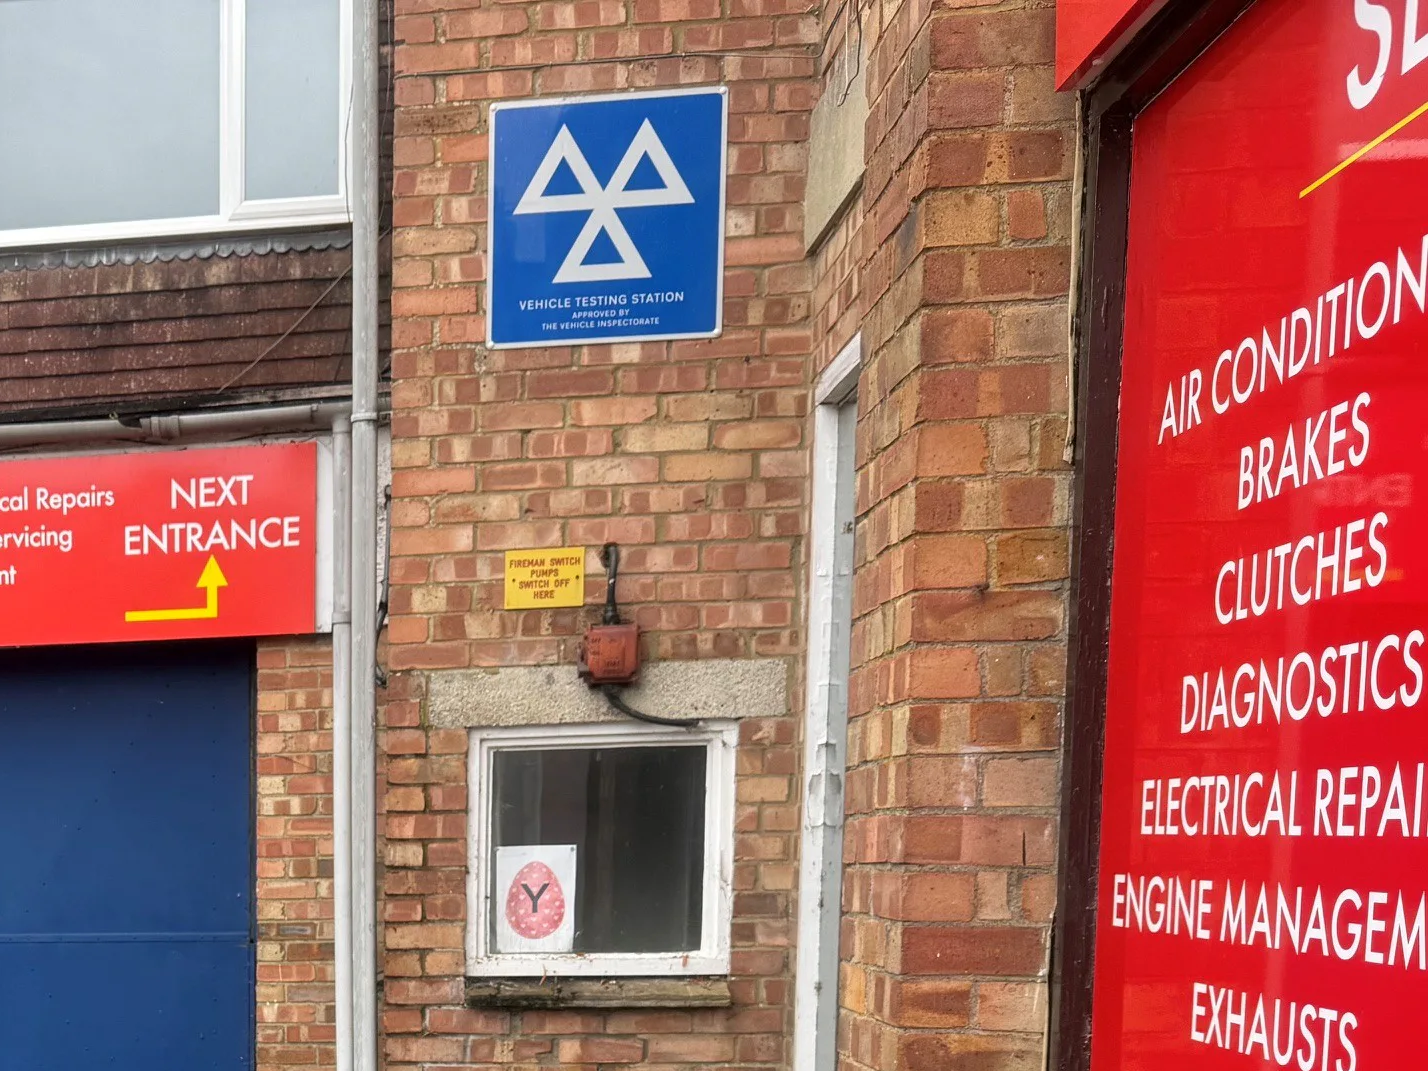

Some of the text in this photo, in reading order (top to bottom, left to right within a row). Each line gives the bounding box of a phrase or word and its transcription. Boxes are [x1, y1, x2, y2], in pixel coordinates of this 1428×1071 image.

[519, 291, 684, 311] VEHICLE TESTING STATION
[571, 308, 630, 320] APPROVED BY
[542, 316, 660, 331] THE VEHICLE INSPECTORATE
[1158, 234, 1428, 445] AIR CONDITION
[1236, 390, 1370, 510] BRAKES
[37, 485, 114, 515] Repairs
[171, 475, 253, 509] NEXT
[125, 517, 299, 555] ENTRANCE
[509, 556, 581, 569] FIREMAN SWITCH
[530, 568, 559, 578] PUMPS
[1215, 512, 1388, 624] CLUTCHES
[518, 577, 571, 590] SWITCH OFF
[533, 589, 555, 600] HERE
[1181, 630, 1424, 733] DIAGNOSTICS
[1141, 770, 1301, 836] ELECTRICAL
[520, 883, 550, 913] Y
[1113, 874, 1426, 970] ENGINE MANAGEM
